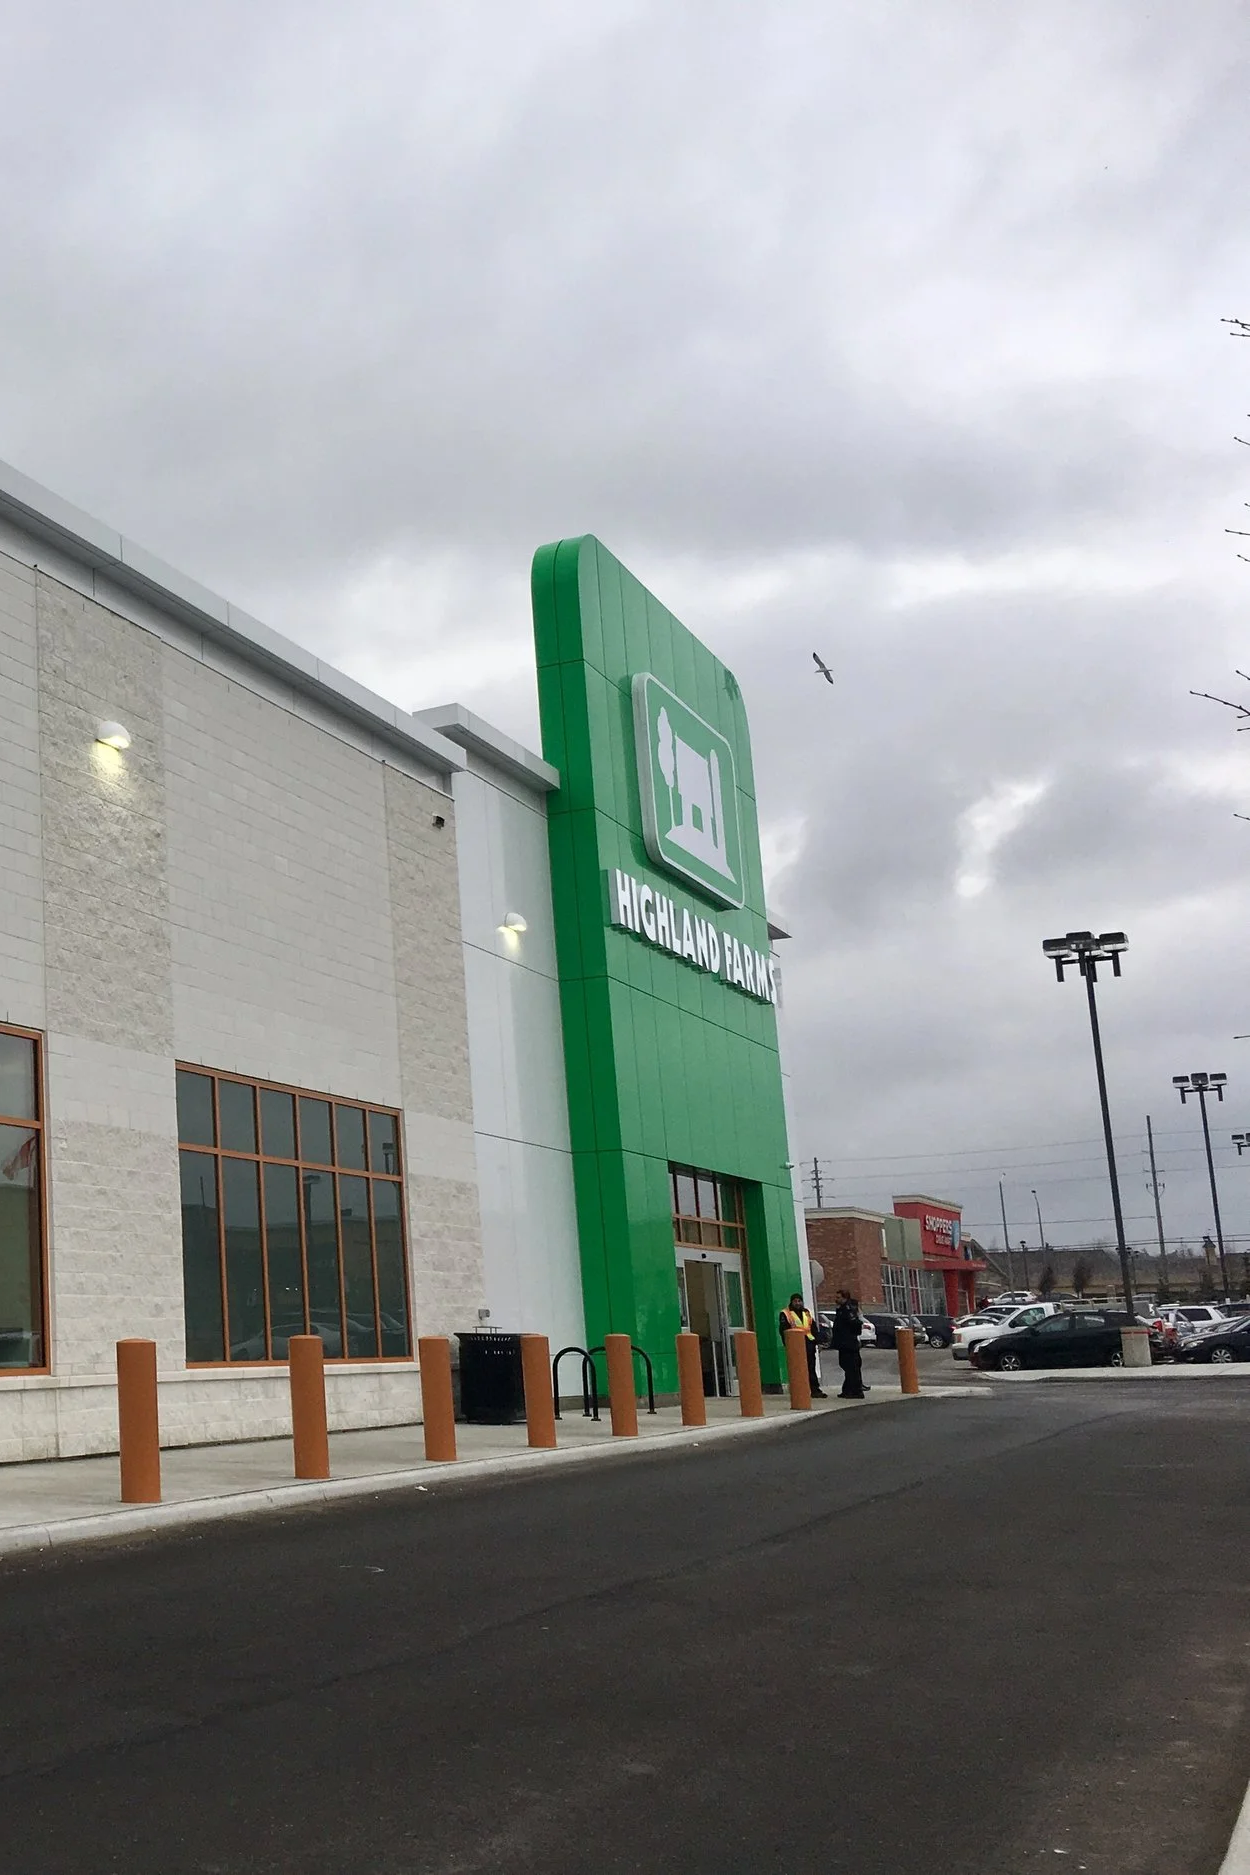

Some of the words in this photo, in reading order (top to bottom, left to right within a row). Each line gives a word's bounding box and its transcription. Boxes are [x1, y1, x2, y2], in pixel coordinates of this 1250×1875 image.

[614, 868, 720, 974] HIGHLAND
[722, 931, 777, 1005] FARMS
[925, 1214, 952, 1235] SHOPPERS
